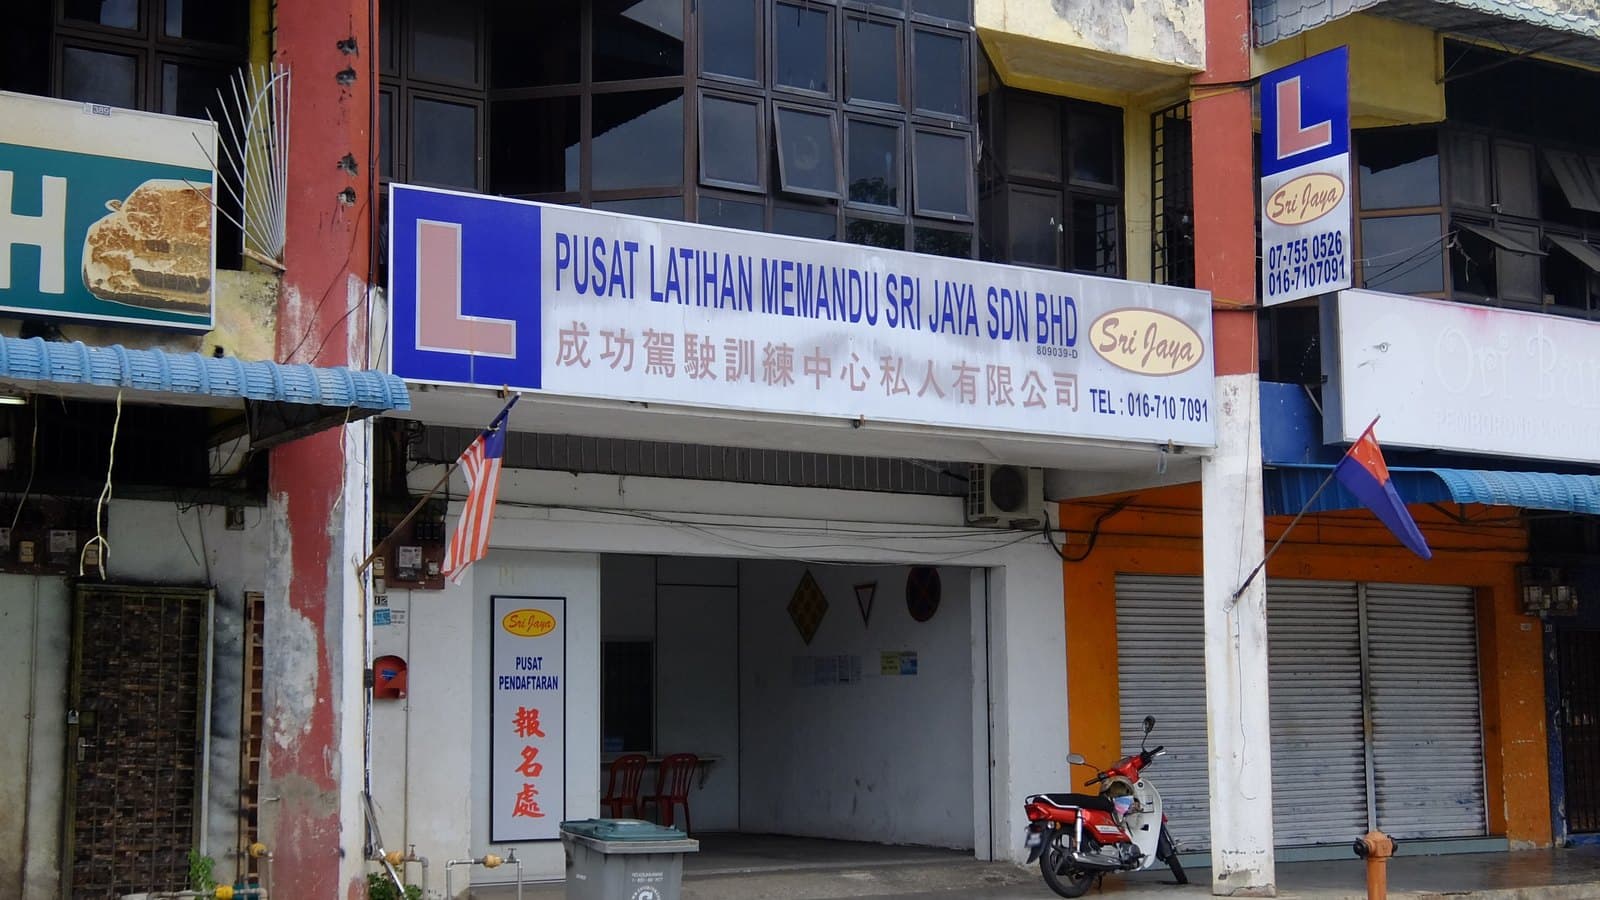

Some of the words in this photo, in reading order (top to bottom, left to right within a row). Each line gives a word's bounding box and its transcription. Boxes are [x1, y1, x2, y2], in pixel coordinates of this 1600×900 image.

[1277, 75, 1331, 160] L
[1272, 190, 1298, 218] Sri
[1300, 183, 1337, 219] Jaya
[1269, 238, 1308, 270] 07-755
[1312, 230, 1342, 260] 0526
[416, 219, 516, 359] L
[555, 232, 638, 299] PUSAT
[650, 244, 752, 312] LATIHAN
[761, 257, 877, 326] MEMANDU
[885, 273, 920, 330] SRI
[929, 279, 979, 337] JAYA
[987, 286, 1028, 342] SDN
[1036, 293, 1077, 347] BHD
[1268, 255, 1345, 296] 016-7107091
[1036, 345, 1078, 359] 809039-D
[1099, 317, 1137, 355] Sri
[1141, 322, 1194, 369] Jaya
[555, 320, 1079, 412] 成功駕駛訓練中心私人有限公司
[1089, 388, 1116, 414] TEL
[1127, 391, 1176, 420] 016-710
[1180, 397, 1208, 423] 7091
[508, 614, 526, 629] Sri
[527, 614, 552, 632] Jaya
[498, 675, 559, 691] PENDAFTARAN
[515, 656, 543, 671] PUSAT
[512, 706, 545, 818] 報名處
